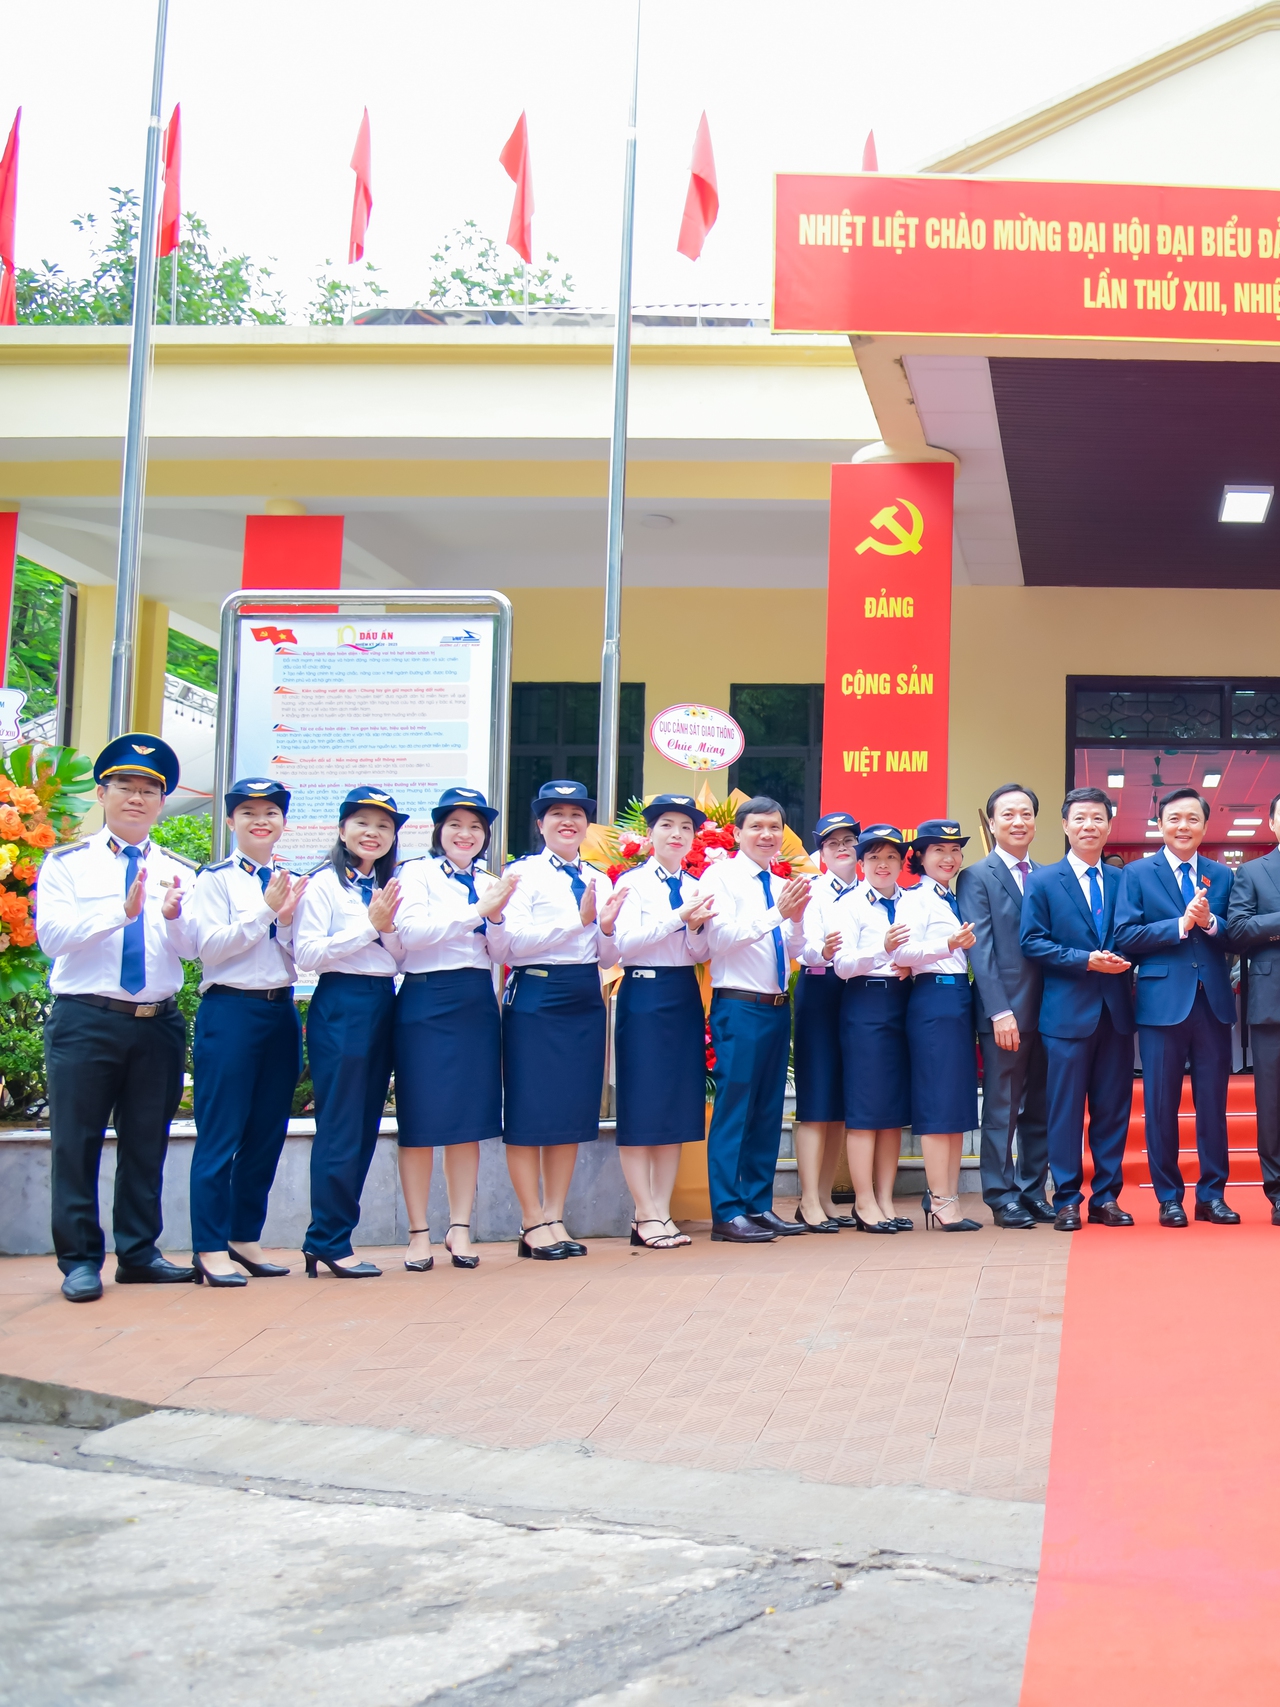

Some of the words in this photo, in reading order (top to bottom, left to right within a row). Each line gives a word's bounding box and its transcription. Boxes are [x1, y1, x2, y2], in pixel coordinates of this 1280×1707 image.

[799, 209, 866, 253] NHIỆT
[873, 210, 919, 254] LIỆT
[926, 212, 986, 250] CHÀO
[994, 213, 1061, 251] MỪNG
[1068, 222, 1105, 259] ĐẠI
[1113, 217, 1150, 260] HỘI
[1157, 225, 1194, 262] ĐẠI
[1202, 215, 1251, 258] BIỂU
[1084, 268, 1127, 308] LẦN
[1134, 272, 1179, 310] THỨ
[1183, 281, 1226, 316] XIII,
[865, 588, 913, 617] ĐẢNG
[359, 629, 378, 640] DẤU
[381, 629, 393, 640] ẤN
[842, 669, 890, 699] CỘNG
[897, 665, 933, 694] SẢN
[660, 721, 671, 734] CỤC
[673, 719, 688, 734] CẢNH
[689, 722, 700, 736] SÁT
[701, 725, 715, 738] GIAO
[716, 725, 735, 740] THÔNG
[667, 738, 693, 752] Chúc
[695, 741, 726, 757] Mừng
[843, 747, 880, 776] VIỆT
[886, 751, 928, 771] NAM
